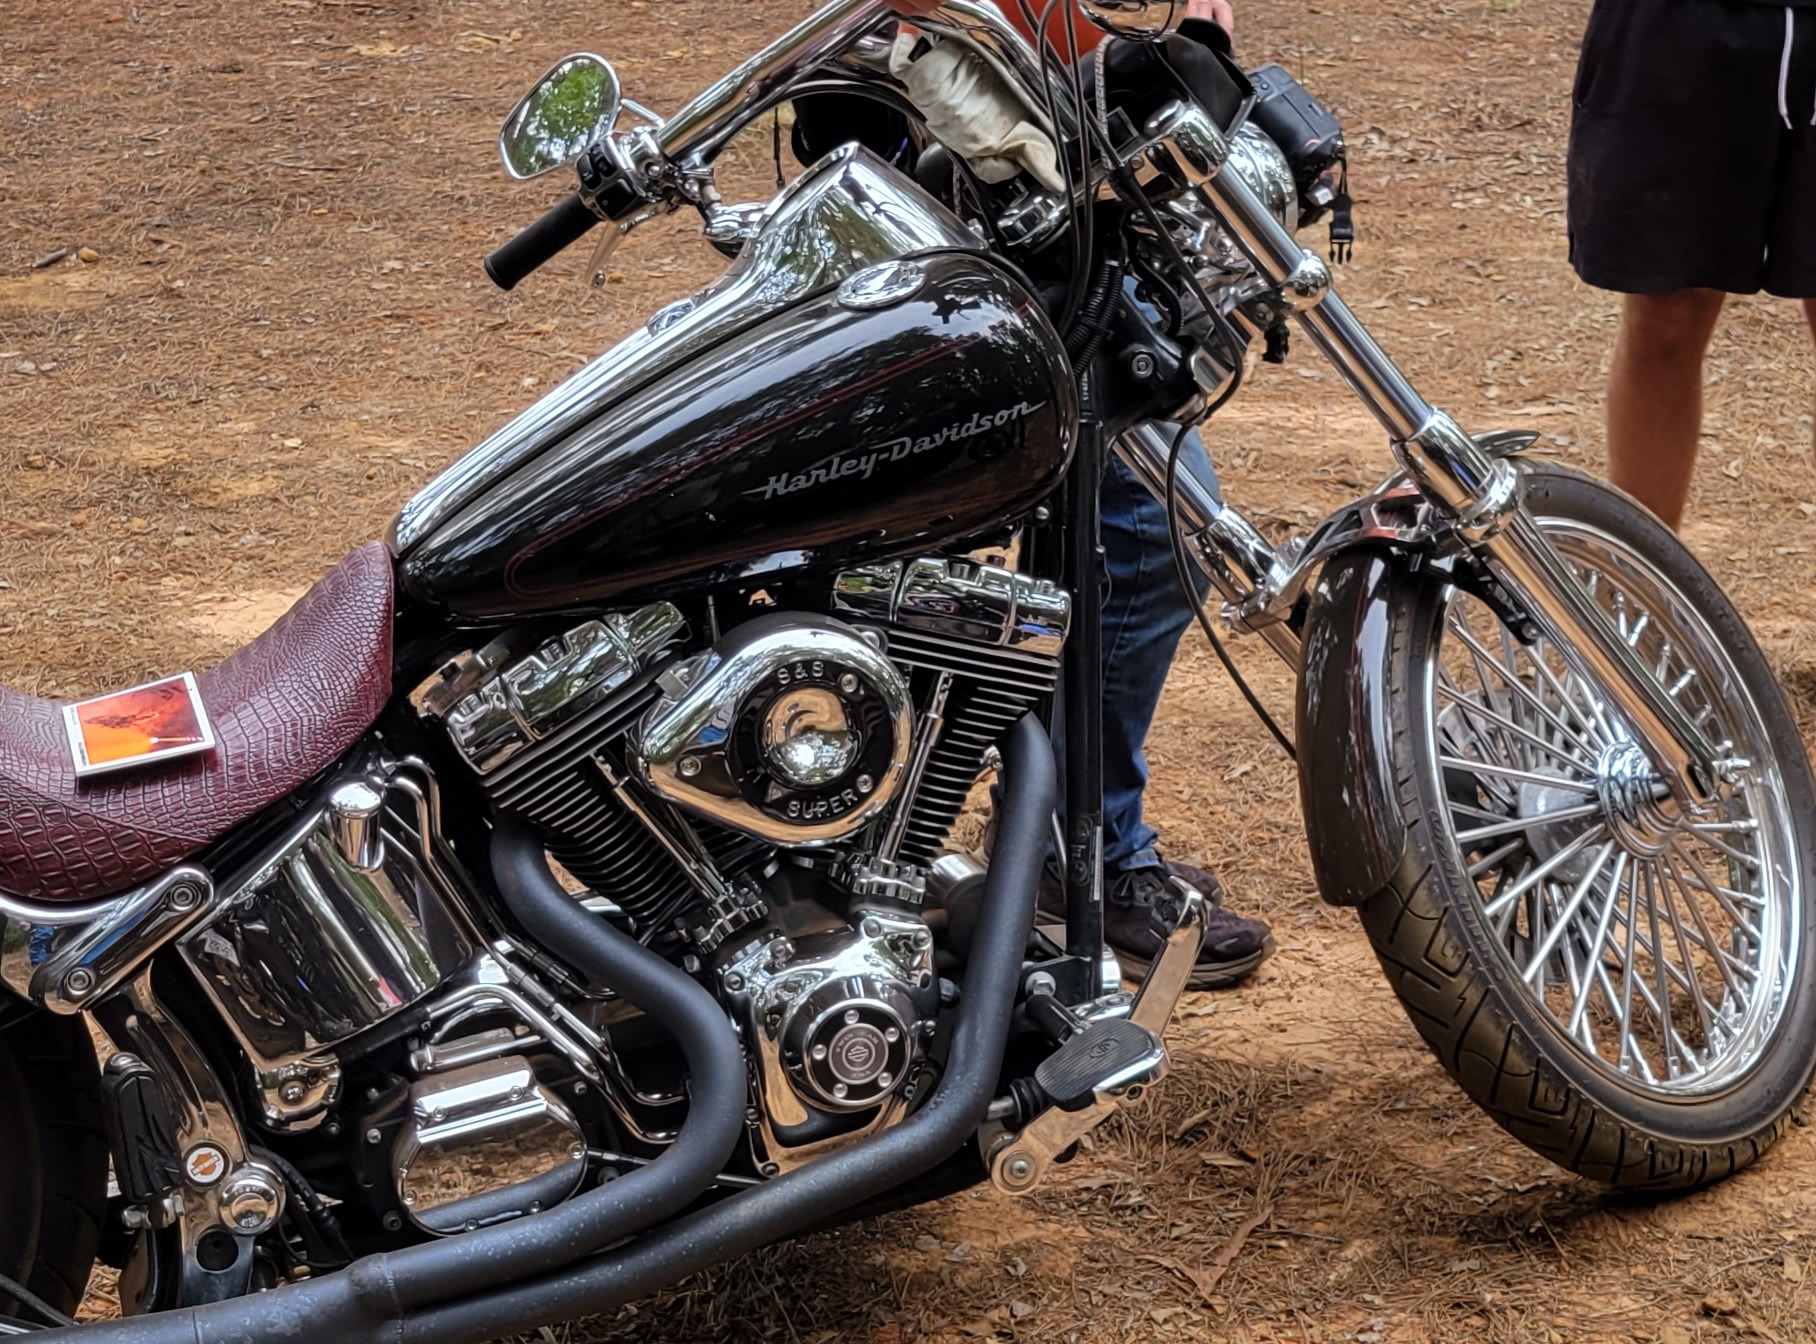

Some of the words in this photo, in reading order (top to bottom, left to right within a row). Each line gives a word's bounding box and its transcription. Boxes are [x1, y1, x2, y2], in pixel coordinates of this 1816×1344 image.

[742, 400, 1047, 500] Harley-Davidson
[777, 661, 825, 684] S&S
[787, 788, 858, 819] SUPER
